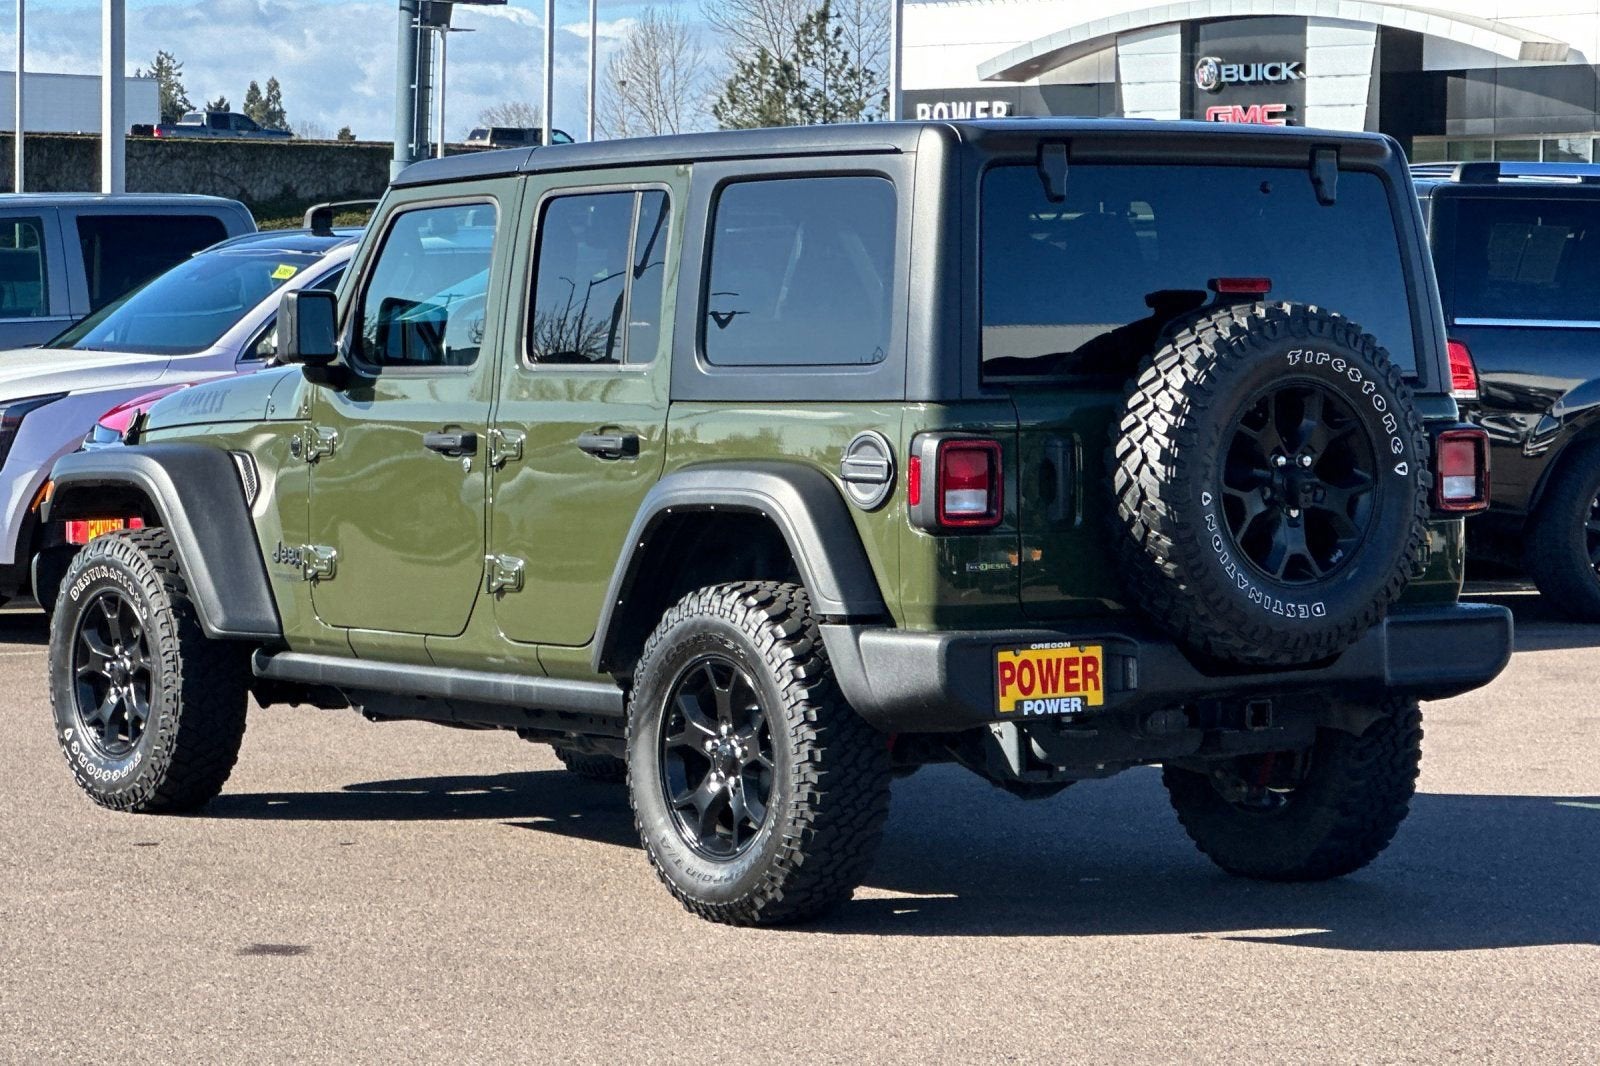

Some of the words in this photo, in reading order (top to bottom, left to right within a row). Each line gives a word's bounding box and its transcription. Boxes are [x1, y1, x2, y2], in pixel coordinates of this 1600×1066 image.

[1220, 61, 1301, 82] BUICK
[916, 100, 1007, 120] POWER
[1205, 103, 1287, 126] GMC
[272, 541, 303, 569] Jeep
[1204, 513, 1326, 619] DESTINATION
[70, 565, 142, 608] DESTINATION
[1030, 641, 1071, 650] OREGON
[999, 656, 1100, 698] POWER
[1023, 697, 1082, 716] POWER
